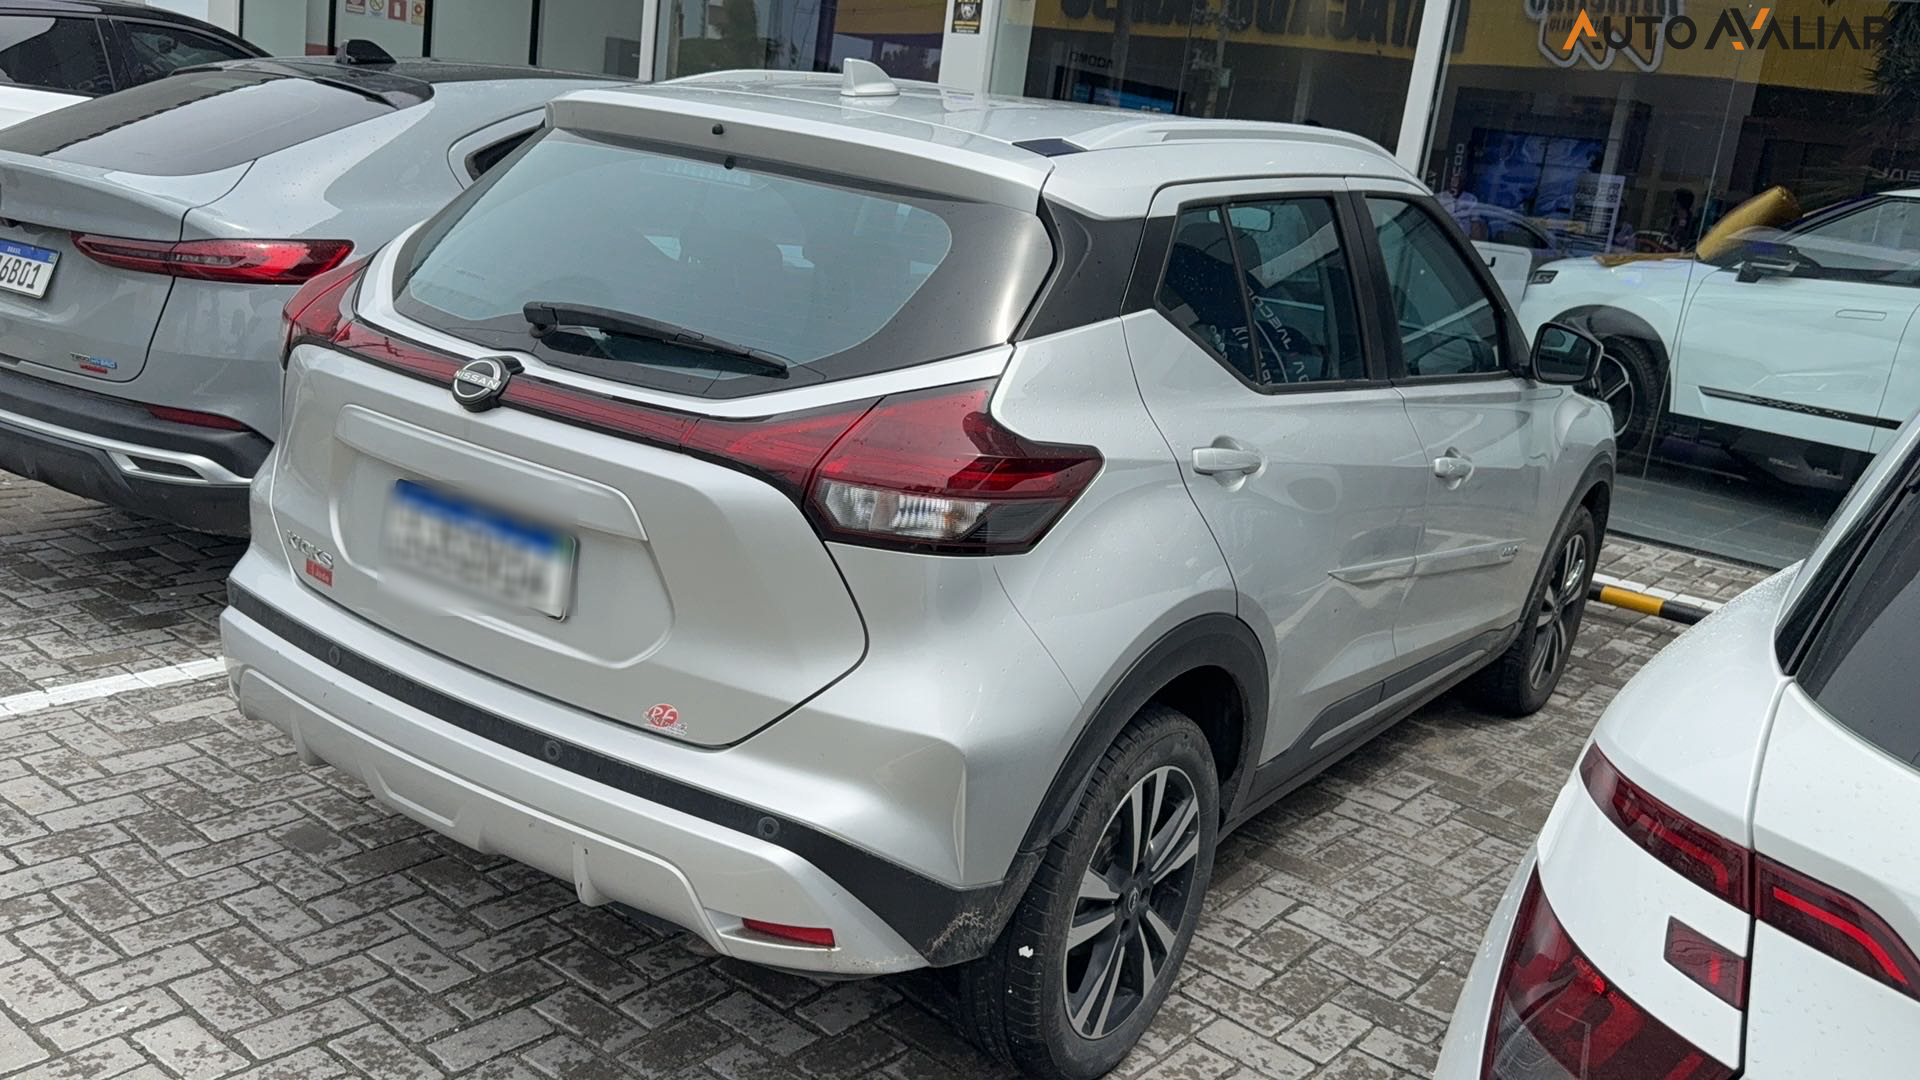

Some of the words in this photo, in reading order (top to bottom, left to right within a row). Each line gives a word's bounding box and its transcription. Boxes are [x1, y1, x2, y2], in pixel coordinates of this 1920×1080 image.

[0, 255, 41, 289] 6B01
[454, 370, 499, 389] NISSAN
[286, 529, 334, 569] KICKS
